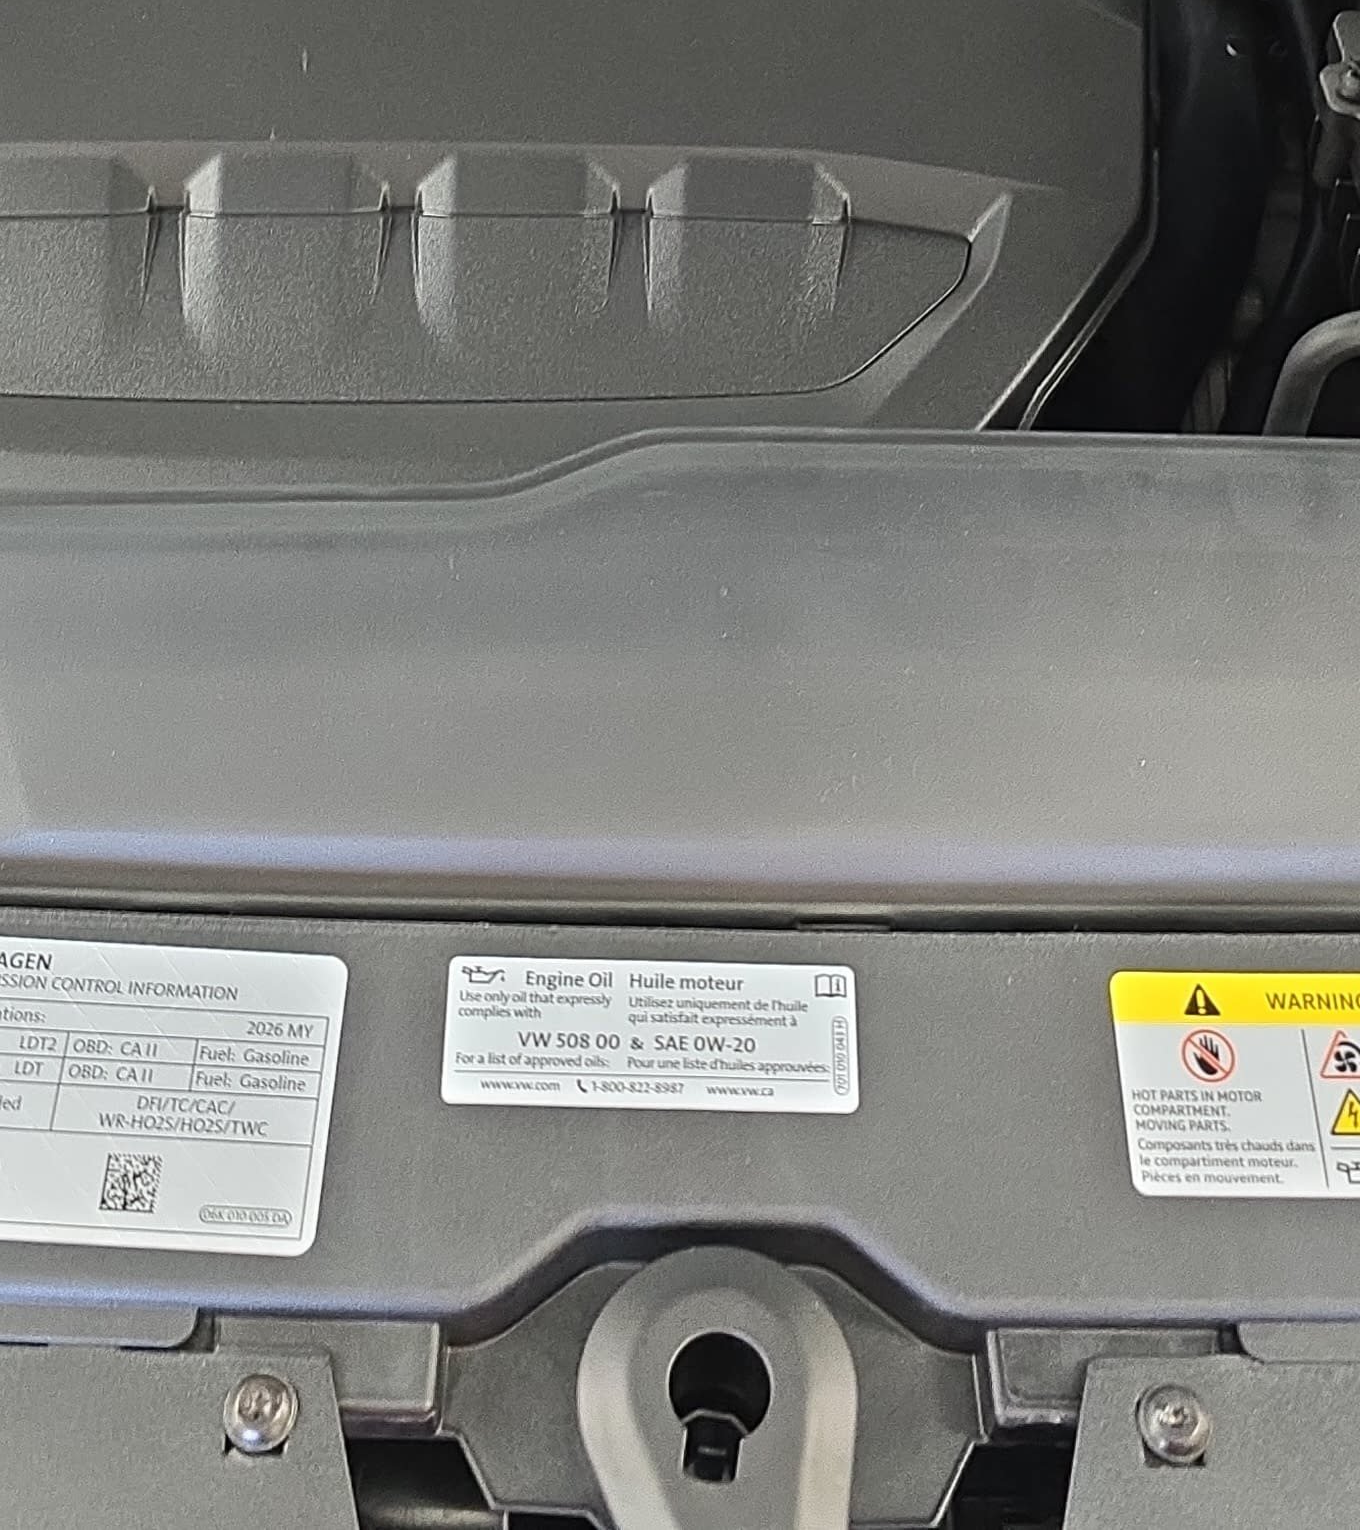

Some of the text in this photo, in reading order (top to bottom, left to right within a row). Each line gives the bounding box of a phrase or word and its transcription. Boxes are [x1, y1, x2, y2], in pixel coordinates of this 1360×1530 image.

[51, 976, 123, 995] CONTROL
[128, 980, 239, 1001] INFORMATION
[526, 971, 613, 991] Engine Oil
[629, 973, 744, 991] Huile moteur
[459, 989, 612, 1008] Use only oil that expressly
[628, 995, 809, 1013] Utilisez uniquement de l'huile
[458, 1006, 542, 1020] complies with
[628, 1012, 797, 1028] qui satisfait expressément à
[247, 1020, 314, 1039] 2026 MY
[18, 1034, 58, 1051] LDT2
[73, 1038, 113, 1055] OBD:
[120, 1041, 141, 1057] CA
[199, 1045, 236, 1063] Fuel:
[243, 1048, 311, 1067] Gasoline
[518, 1031, 756, 1053] VW 508 00 & SAE 0W-20
[455, 1052, 610, 1069] For a list of approved oils:
[627, 1056, 655, 1070] Pour
[658, 1059, 681, 1070] une
[683, 1056, 708, 1071] liste
[710, 1057, 755, 1072] d'huiles
[14, 1060, 44, 1077] LDT
[68, 1063, 109, 1081] OBD:
[116, 1067, 137, 1082] CA
[195, 1070, 232, 1088] Fuel:
[240, 1073, 306, 1093] Gasoline
[481, 1079, 561, 1091] www.vw.com
[706, 1086, 774, 1097] www.vw.ca
[1132, 1089, 1262, 1102] HOT PARTS IN MOTOR
[137, 1095, 236, 1117] DFI/TC/CAC/
[1134, 1105, 1231, 1117] COMPARTMENT.
[1135, 1120, 1231, 1132] MOVING PARTS.
[1138, 1137, 1316, 1153] Composants très chauds dans
[1139, 1156, 1298, 1170] le compartiment moteur.
[1141, 1170, 1284, 1184] Pièces en mouvement.
